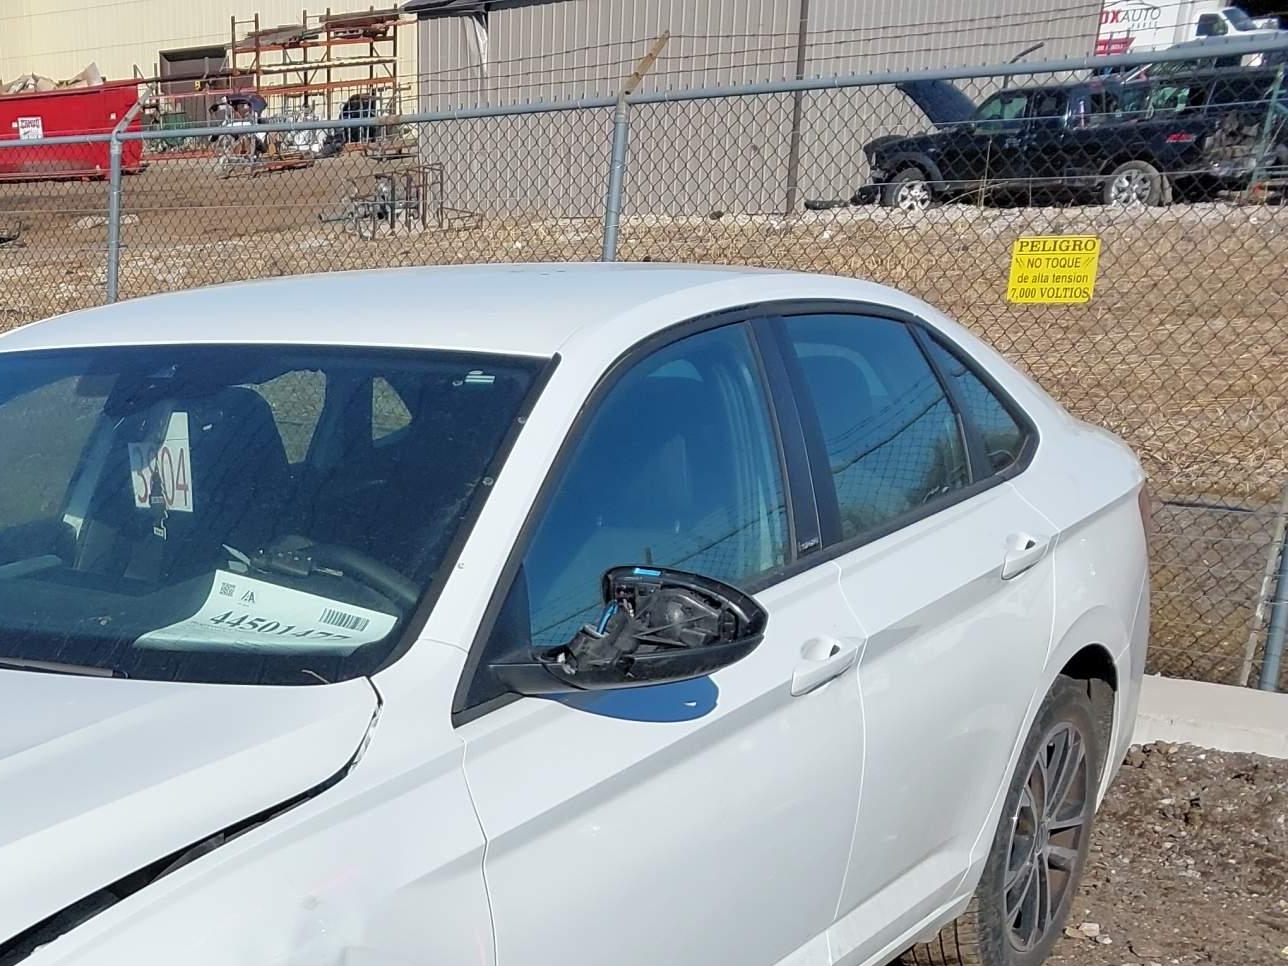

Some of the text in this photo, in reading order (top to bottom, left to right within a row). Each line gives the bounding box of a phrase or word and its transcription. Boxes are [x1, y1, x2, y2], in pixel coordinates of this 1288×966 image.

[1019, 240, 1096, 252] PELIGRO
[1027, 257, 1081, 269] NO TOQUE
[1017, 273, 1088, 284] de alta tension
[1011, 287, 1089, 299] 7,000 VOLTIOS
